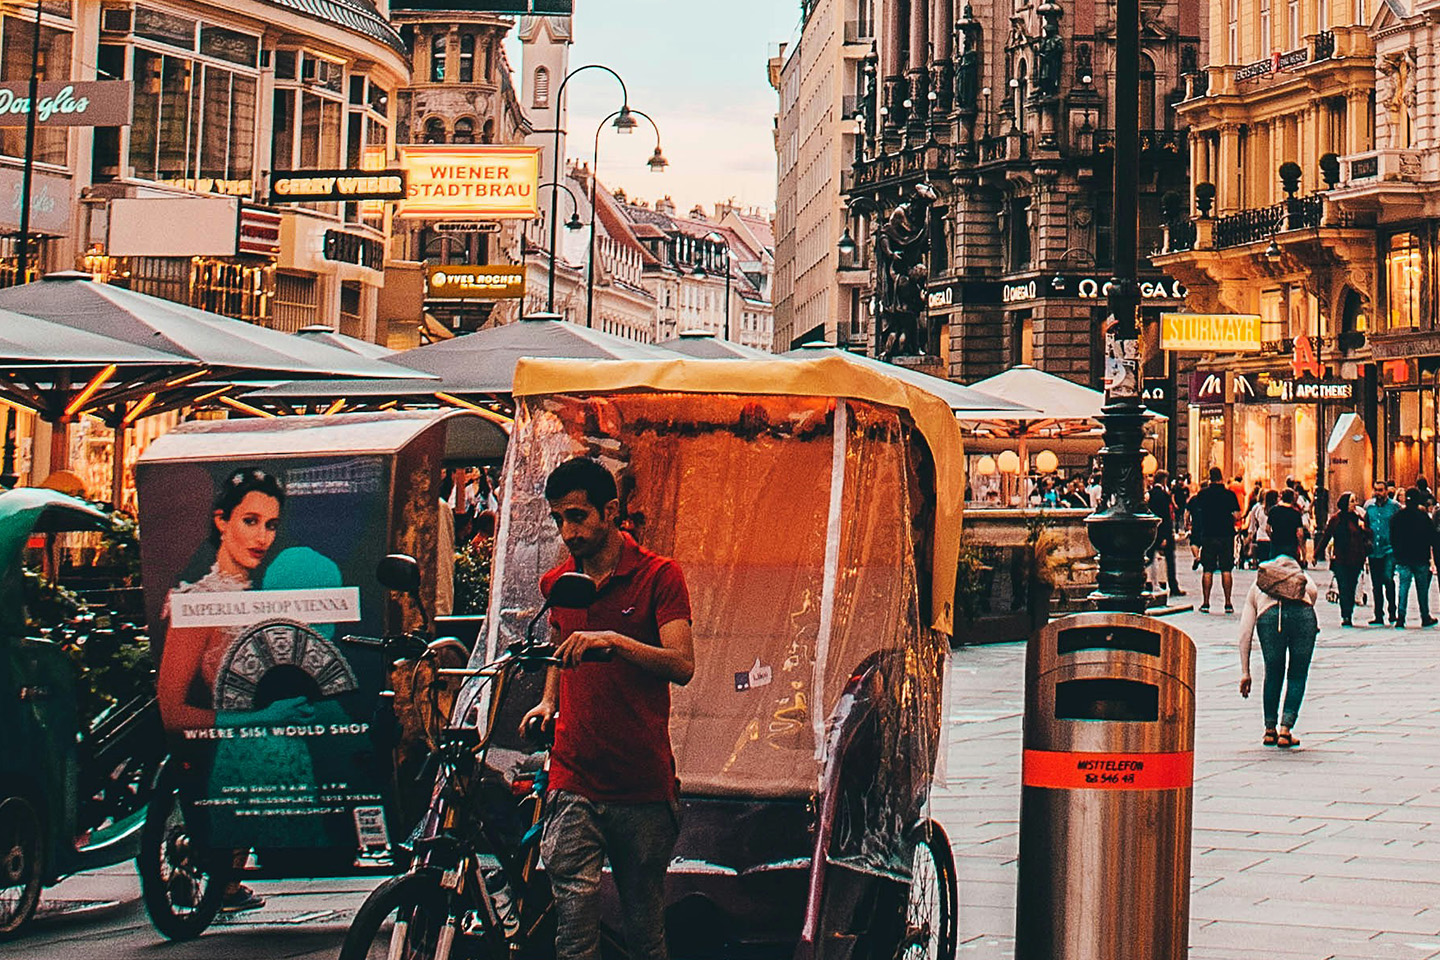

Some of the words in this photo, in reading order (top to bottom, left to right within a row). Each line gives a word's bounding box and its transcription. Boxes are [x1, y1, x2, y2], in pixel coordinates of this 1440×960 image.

[430, 166, 509, 179] WIENER
[275, 178, 335, 196] GERRY
[336, 177, 402, 194] WEBER
[447, 274, 475, 284] YVES
[477, 274, 522, 284] ROCHER
[1170, 318, 1255, 341] STURMAYR
[1296, 384, 1351, 398] APOTHEKE
[182, 602, 250, 617] IMPERIAL
[253, 600, 290, 615] SHOP
[294, 598, 348, 612] VIENNA
[184, 728, 234, 739] WHERE
[240, 727, 267, 738] SISI
[272, 725, 325, 736] WOULD
[329, 723, 369, 735] SHOP
[1077, 760, 1144, 771] MISTTELEFON
[1100, 774, 1119, 784] 546
